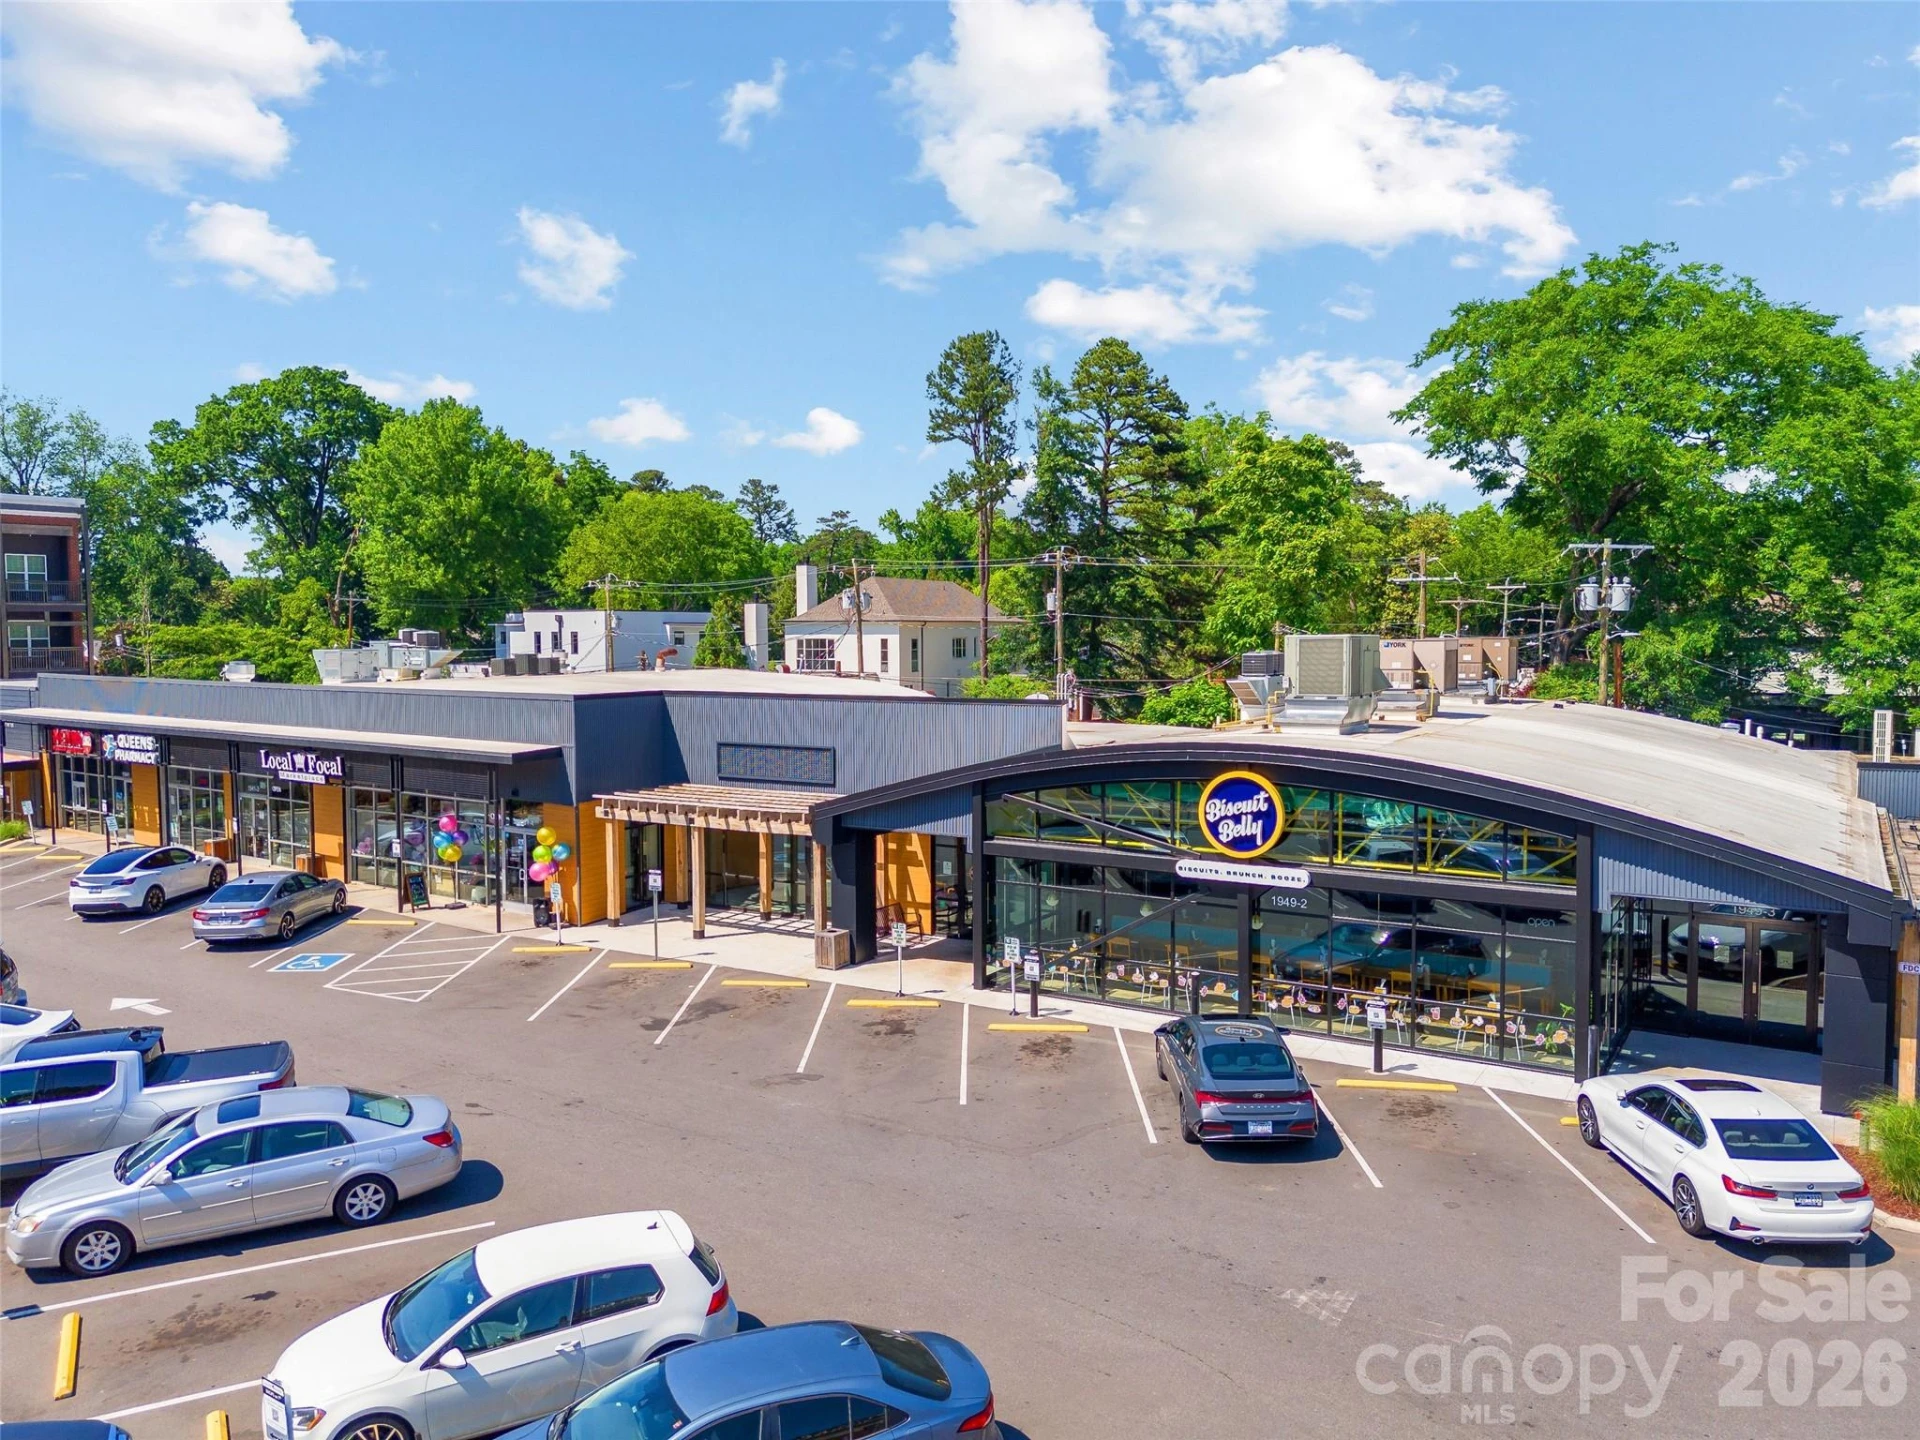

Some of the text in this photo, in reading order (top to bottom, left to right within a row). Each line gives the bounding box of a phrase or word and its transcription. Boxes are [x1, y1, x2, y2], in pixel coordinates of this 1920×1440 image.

[117, 733, 156, 750] QUEENS
[114, 748, 158, 764] PHARMACY
[260, 749, 343, 776] Local Focal
[1205, 790, 1269, 823] Biscuit
[1218, 814, 1263, 846] Belly
[1178, 865, 1306, 883] BISCUITS. BRUNCH. BOOZE.
[1271, 896, 1308, 909] 1949-2
[1527, 917, 1556, 928] open
[1902, 964, 1920, 973] FDC
